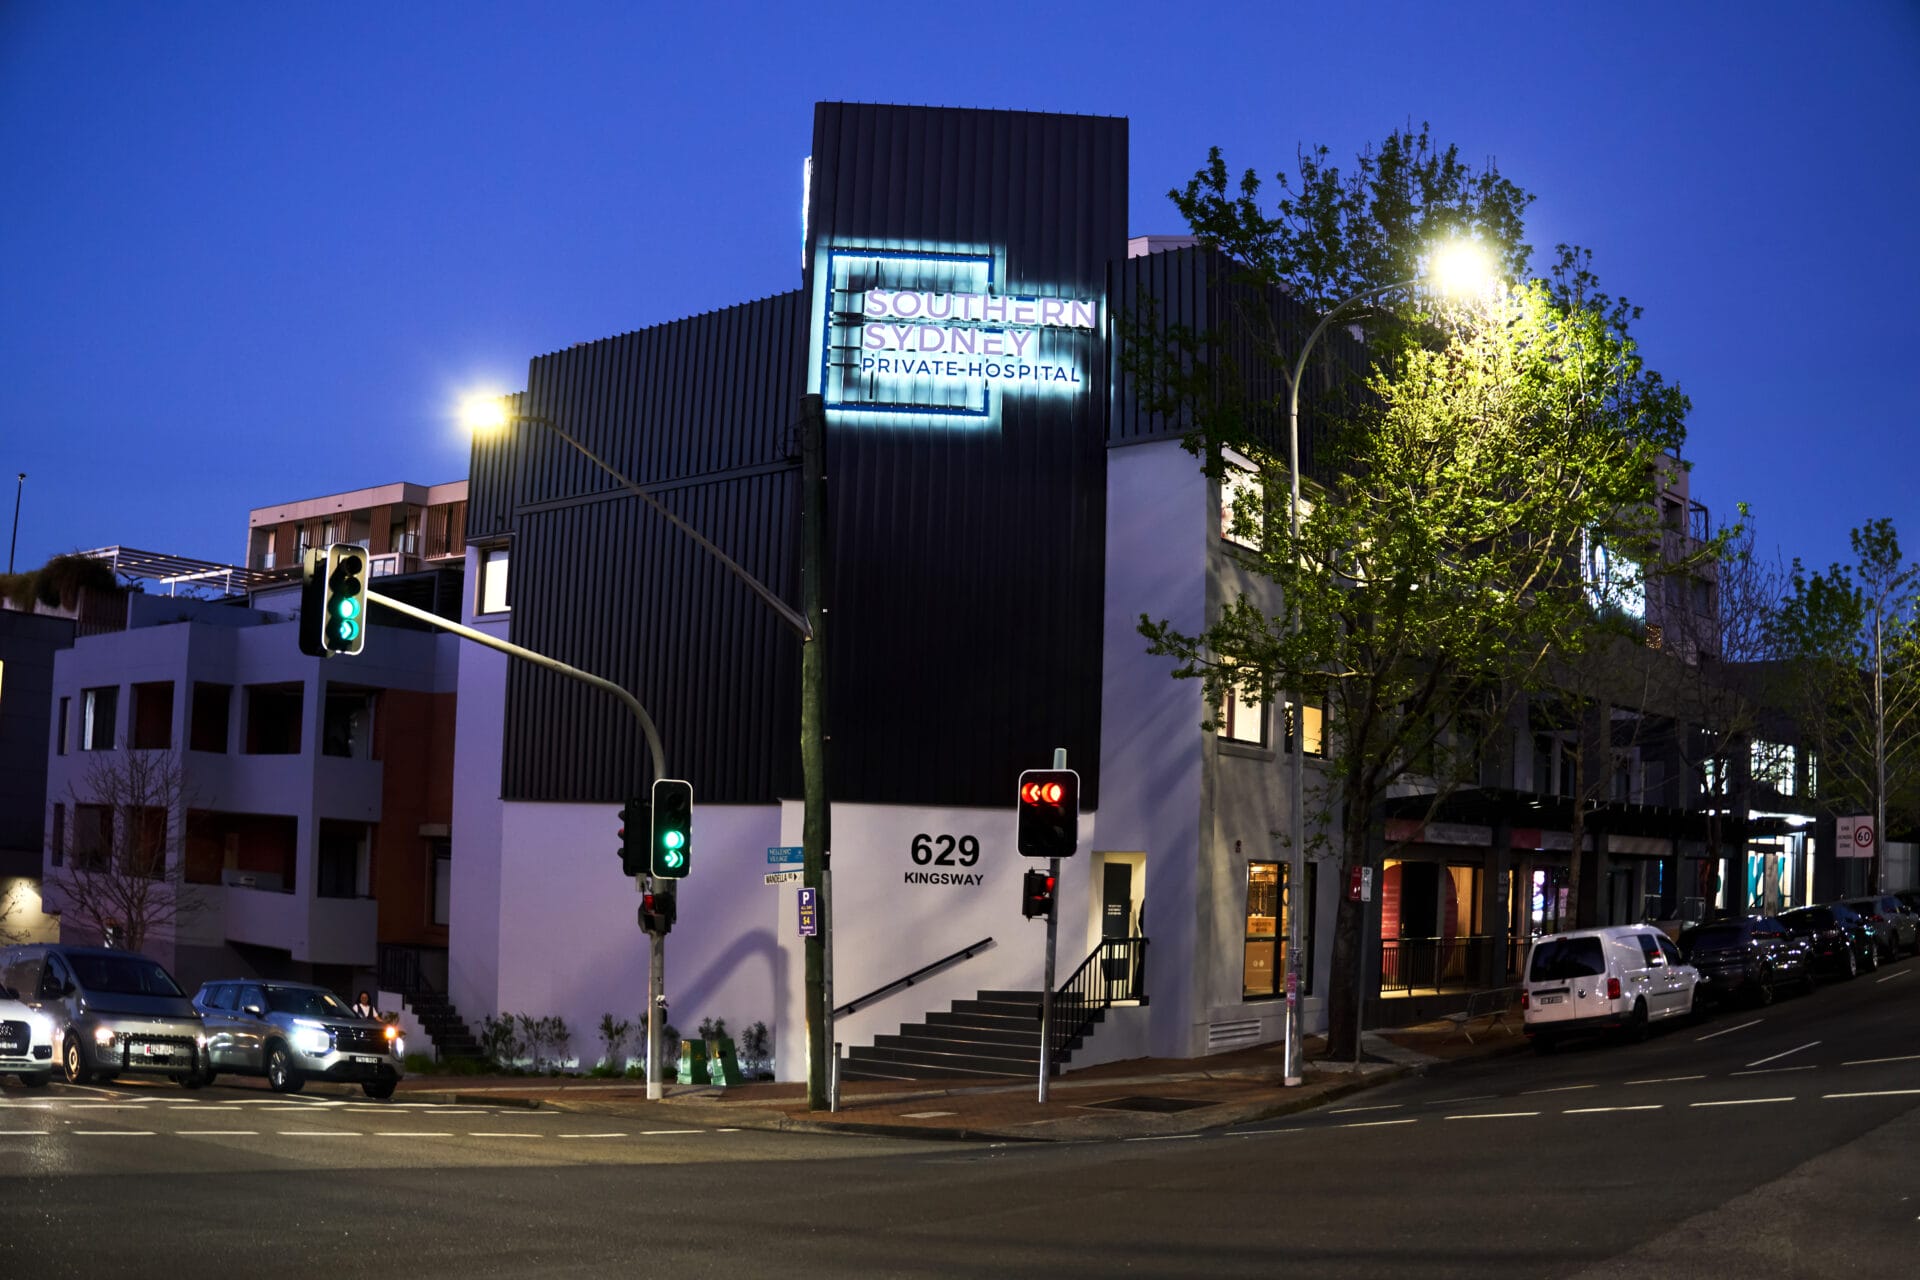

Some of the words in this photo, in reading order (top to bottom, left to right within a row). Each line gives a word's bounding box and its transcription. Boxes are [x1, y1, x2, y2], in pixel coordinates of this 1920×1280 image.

[864, 289, 1096, 329] SOUTHERN
[864, 323, 1031, 357] SYDNEY
[862, 358, 958, 377] PRIVATE
[969, 362, 1081, 383] HOSPITAL
[1858, 832, 1870, 842] 60
[911, 833, 980, 867] 629
[904, 871, 984, 886] KINGSWAY
[803, 891, 810, 905] P
